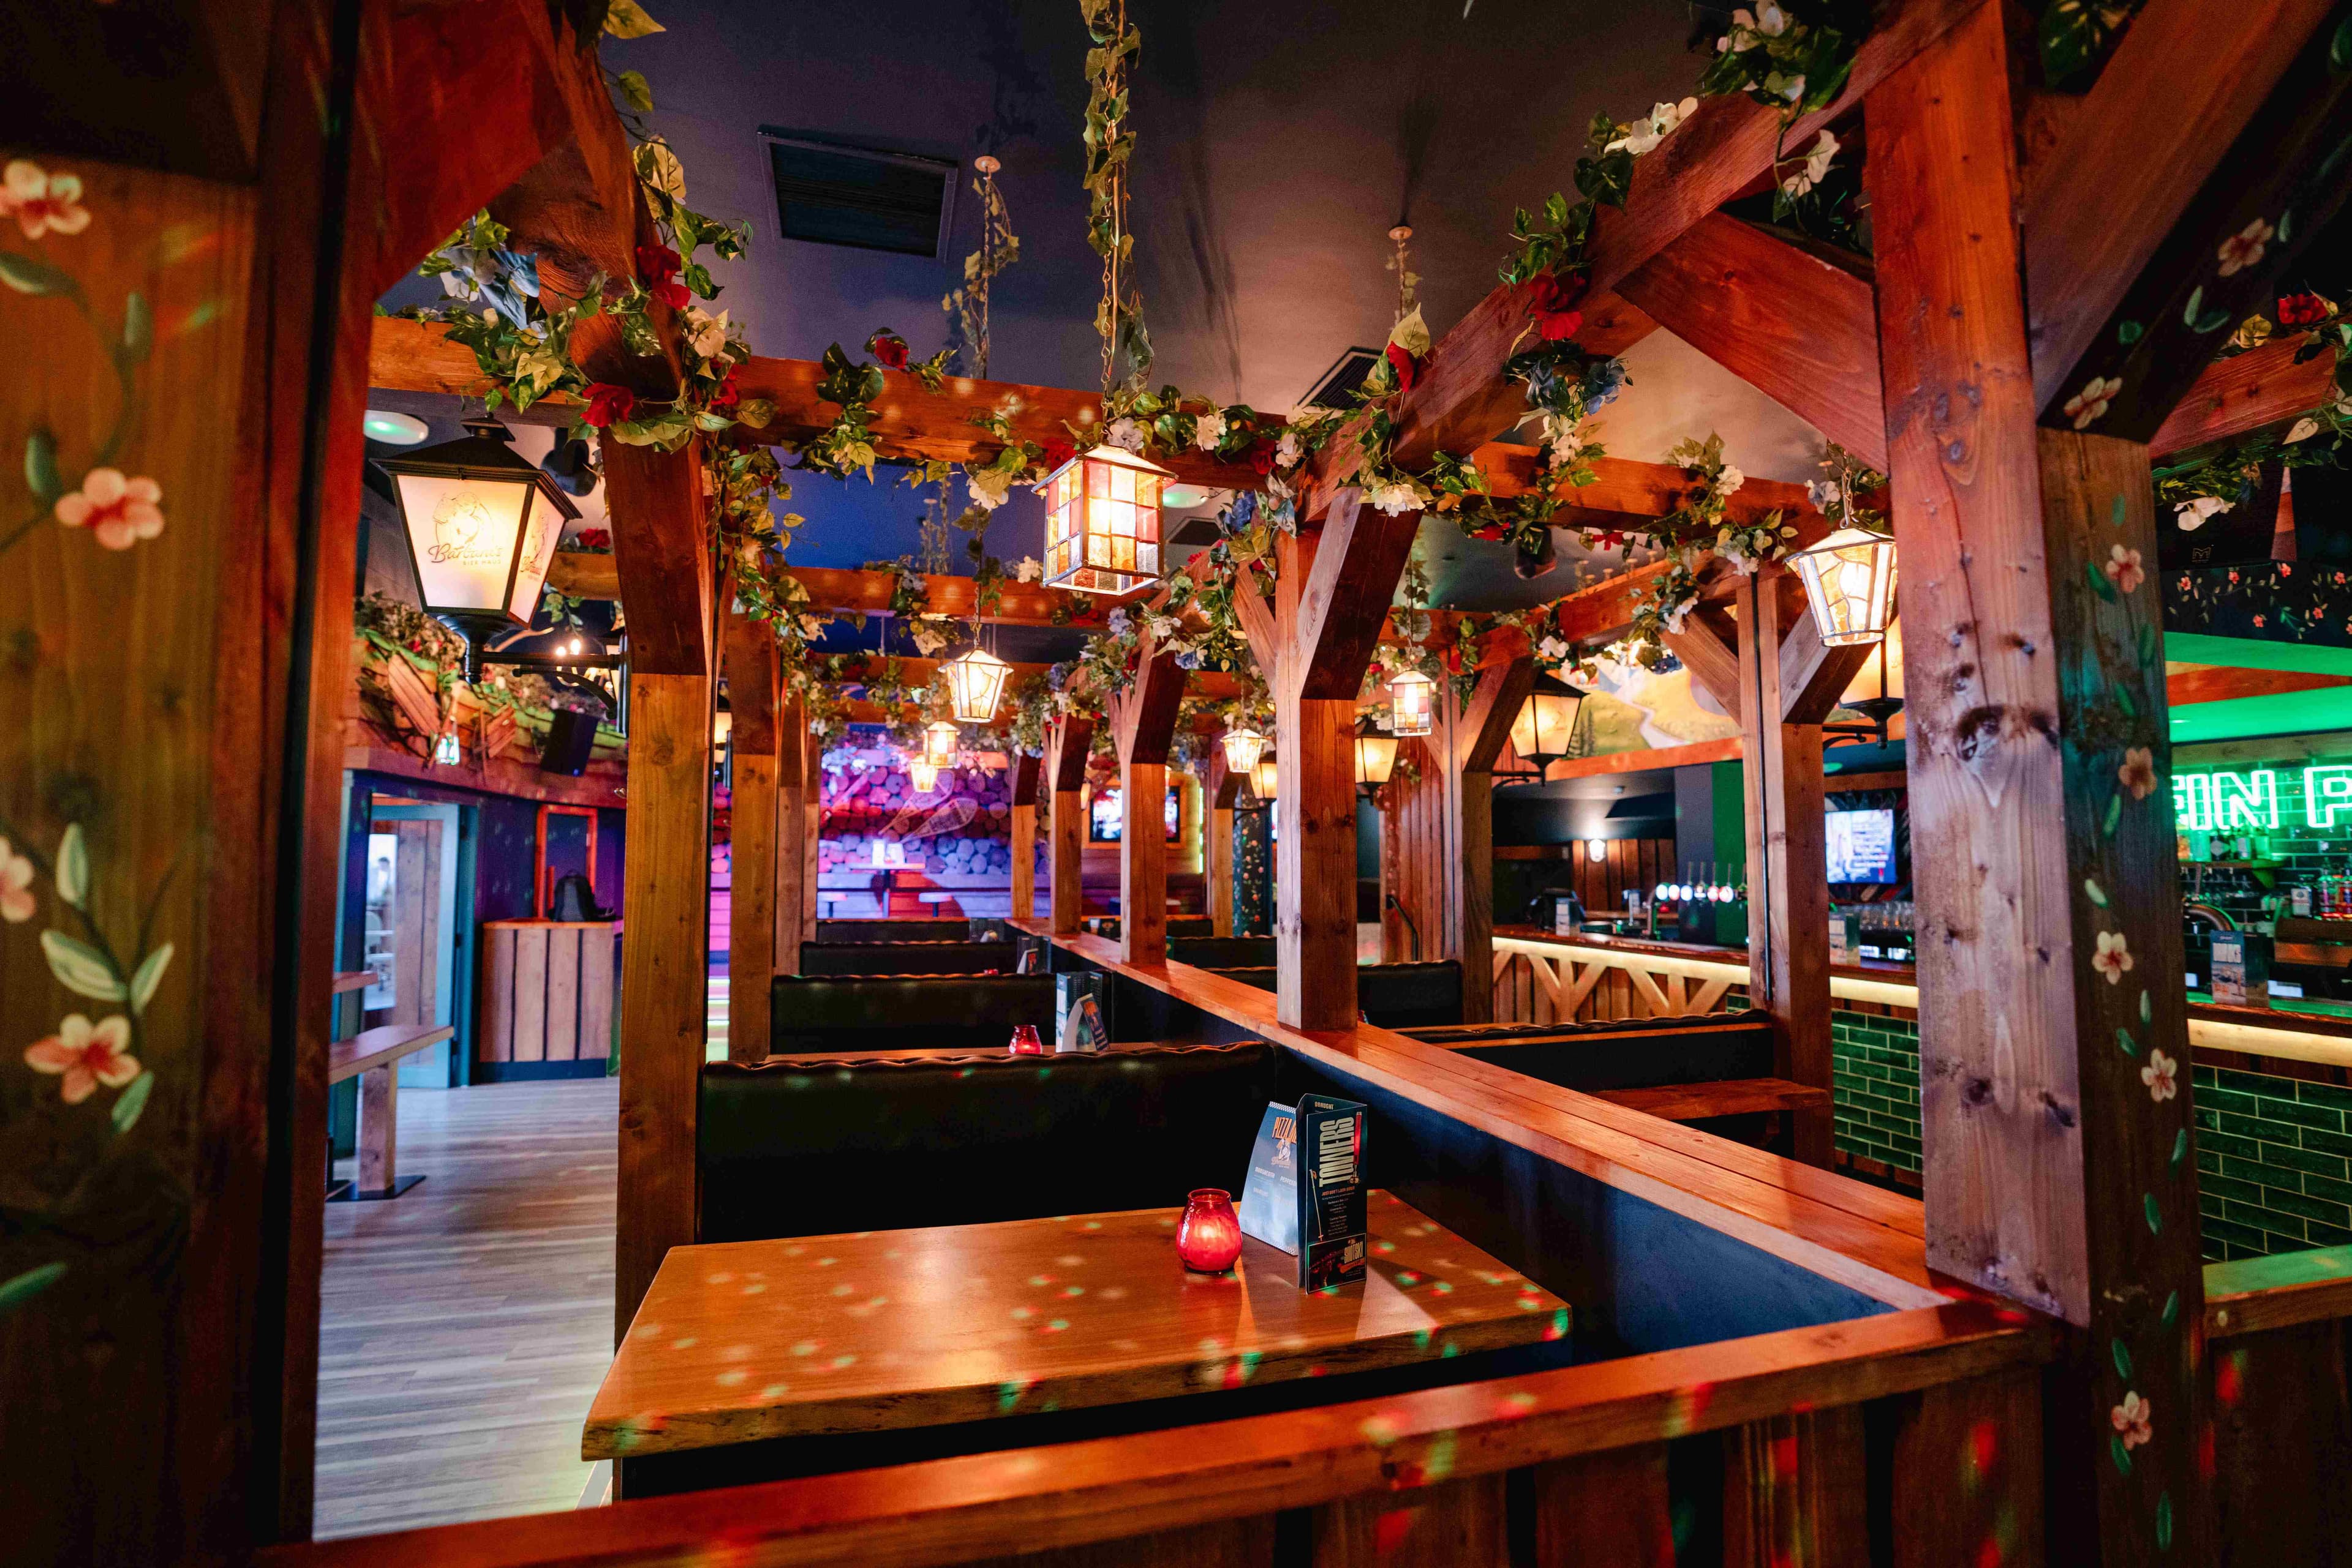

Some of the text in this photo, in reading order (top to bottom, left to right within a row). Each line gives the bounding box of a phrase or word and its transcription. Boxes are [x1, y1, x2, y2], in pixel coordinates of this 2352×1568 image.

[1314, 1101, 1334, 1110] DRAUGHT
[1272, 1117, 1292, 1139] PIZZA
[1319, 1117, 1354, 1187] TOWERS
[1344, 1240, 1363, 1264] SHOTSKI
